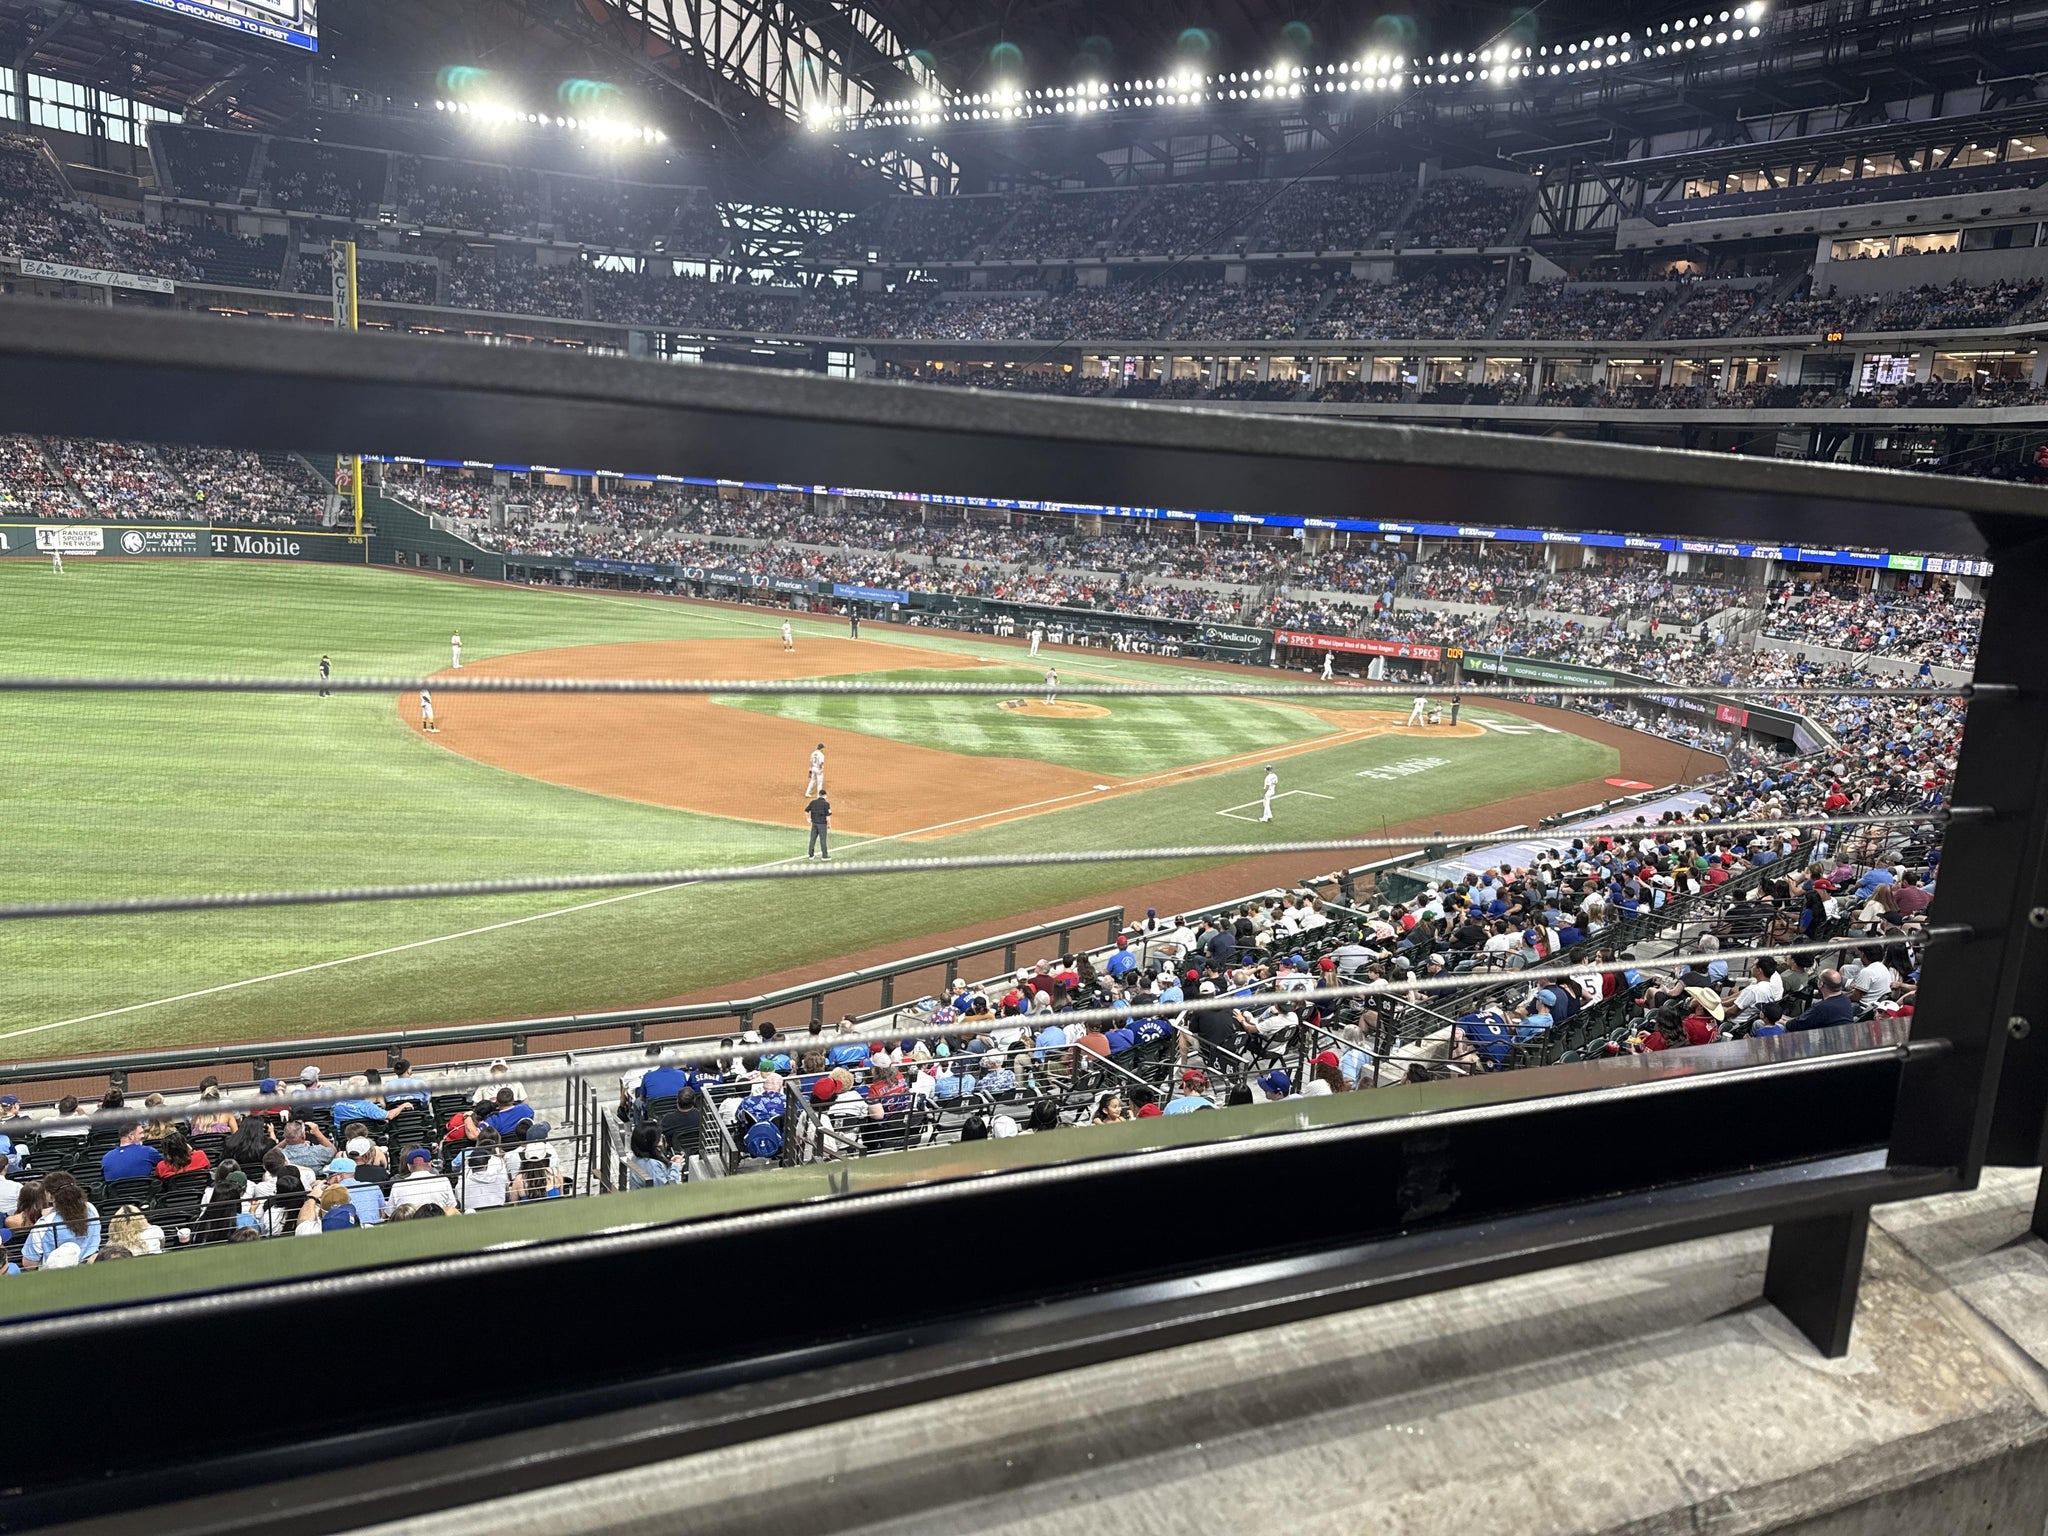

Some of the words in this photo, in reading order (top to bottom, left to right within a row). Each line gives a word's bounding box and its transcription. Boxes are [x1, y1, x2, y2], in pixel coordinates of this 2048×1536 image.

[176, 3, 241, 27] GROUNDED
[242, 20, 258, 32] TO
[259, 26, 290, 40] FIRST
[23, 261, 57, 276] Blue
[60, 268, 102, 282] Mint
[106, 272, 134, 287] Thai
[233, 536, 300, 556] Mobile
[711, 573, 736, 582] American
[775, 580, 802, 589] American
[1219, 632, 1247, 642] Medical
[1247, 635, 1263, 645] City
[1291, 635, 1314, 645] SPEC'S
[1378, 645, 1394, 653] Rangers
[1413, 647, 1438, 658] SPEC'S
[1482, 662, 1508, 673] DaBlla
[1515, 668, 1536, 676] ROOFING
[1563, 675, 1589, 684] WINDOWS
[1684, 701, 1697, 710] Globe
[1697, 703, 1705, 712] Life
[1584, 979, 1596, 995] 5
[1383, 1001, 1390, 1010] 05
[1137, 1022, 1163, 1035] LANGFORD
[1485, 1018, 1501, 1035] 6
[1226, 1064, 1233, 1074] 05
